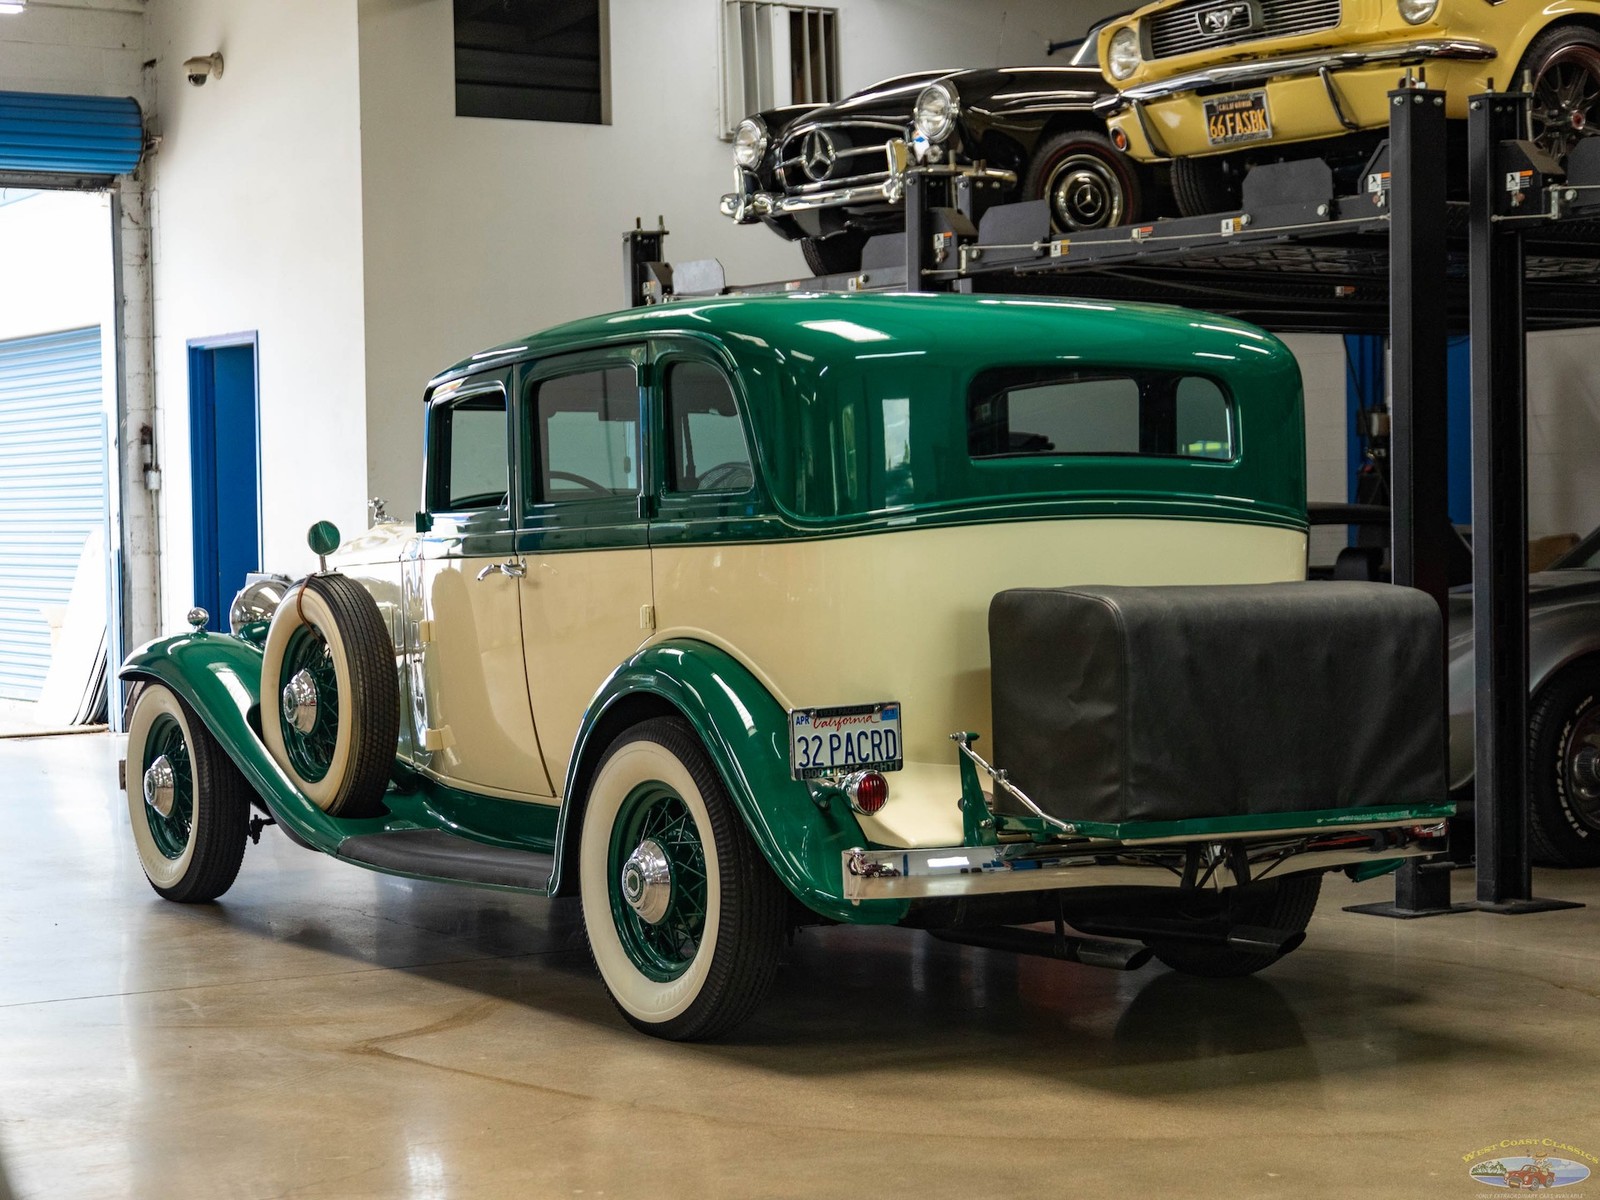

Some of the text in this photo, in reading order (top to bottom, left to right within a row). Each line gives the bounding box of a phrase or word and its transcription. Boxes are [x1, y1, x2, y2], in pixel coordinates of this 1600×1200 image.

[1210, 115, 1226, 139] 66
[1225, 108, 1268, 137] FASBK
[795, 714, 881, 732] APR California
[797, 728, 898, 768] 32 PACRD
